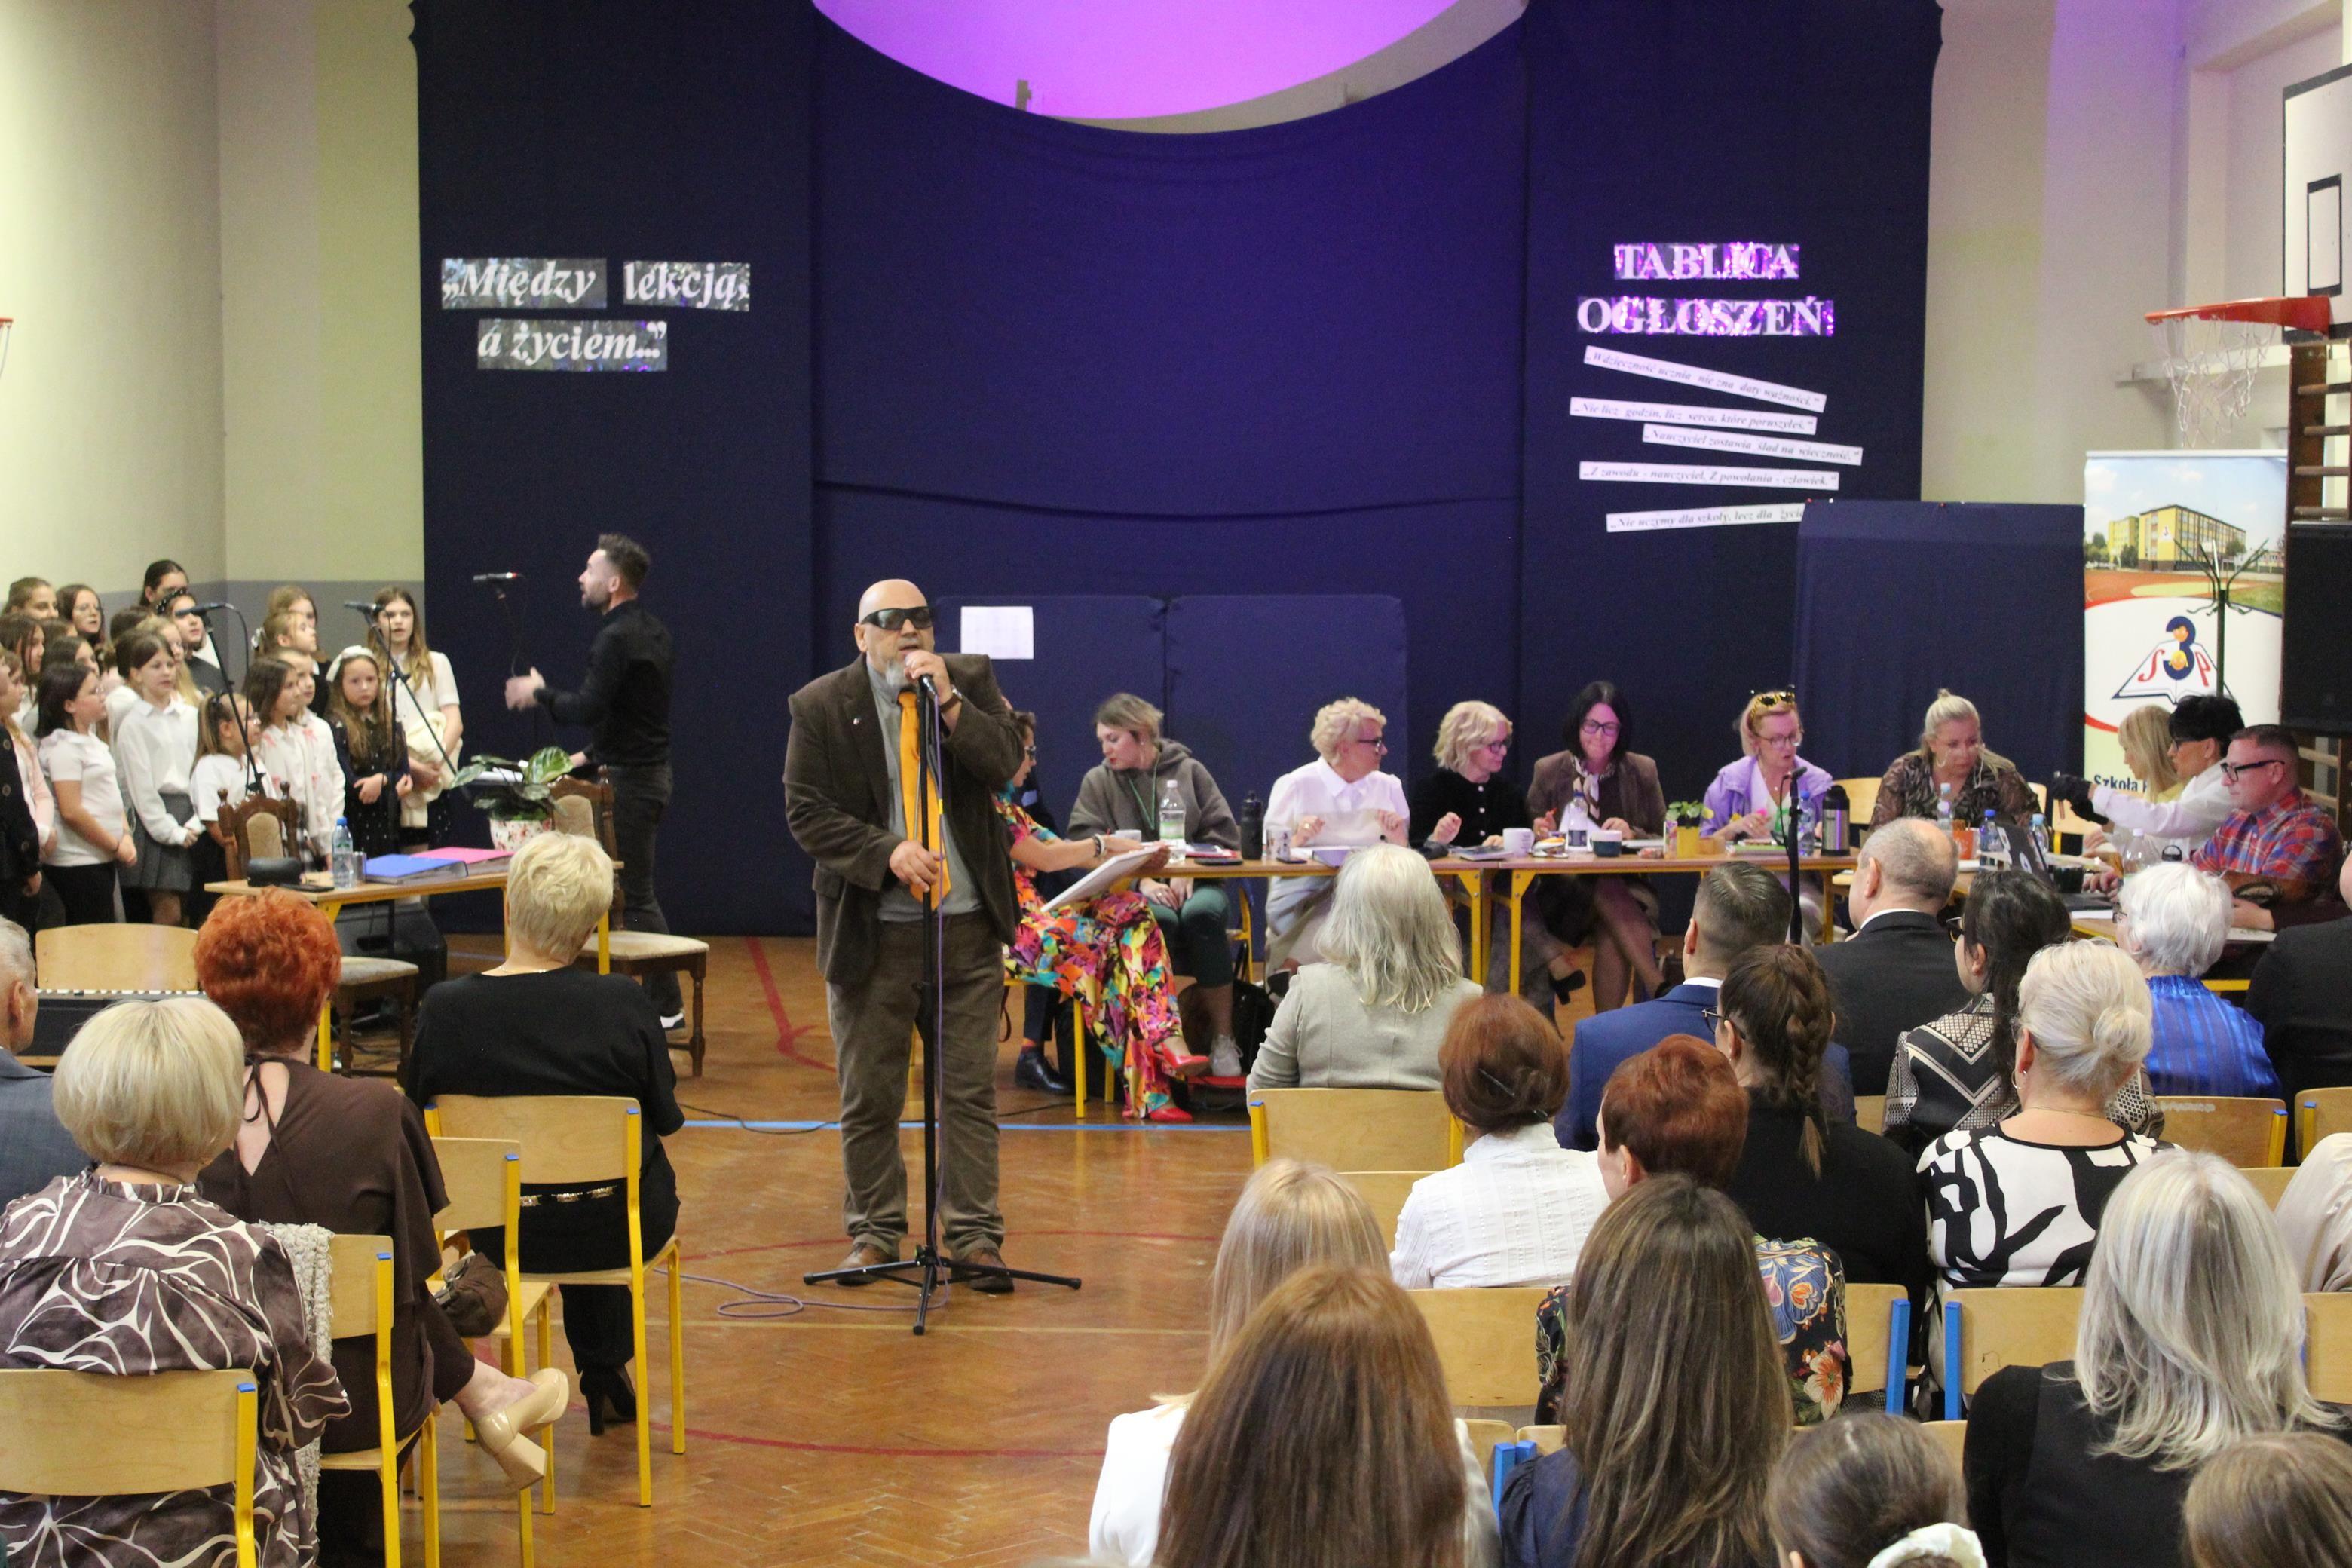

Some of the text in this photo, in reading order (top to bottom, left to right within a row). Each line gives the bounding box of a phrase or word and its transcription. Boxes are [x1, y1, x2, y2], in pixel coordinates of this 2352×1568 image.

[1615, 243, 1799, 280] TABLICA
[1577, 296, 1826, 335] OGŁOSZEŃ
[478, 332, 501, 357] a
[1740, 382, 1761, 396] daty
[1720, 414, 1747, 424] które
[1758, 441, 1779, 452] ślad
[1781, 446, 1795, 455] na
[1678, 513, 1695, 524] dla
[1734, 511, 1754, 520] lecz
[1756, 510, 1773, 519] dla
